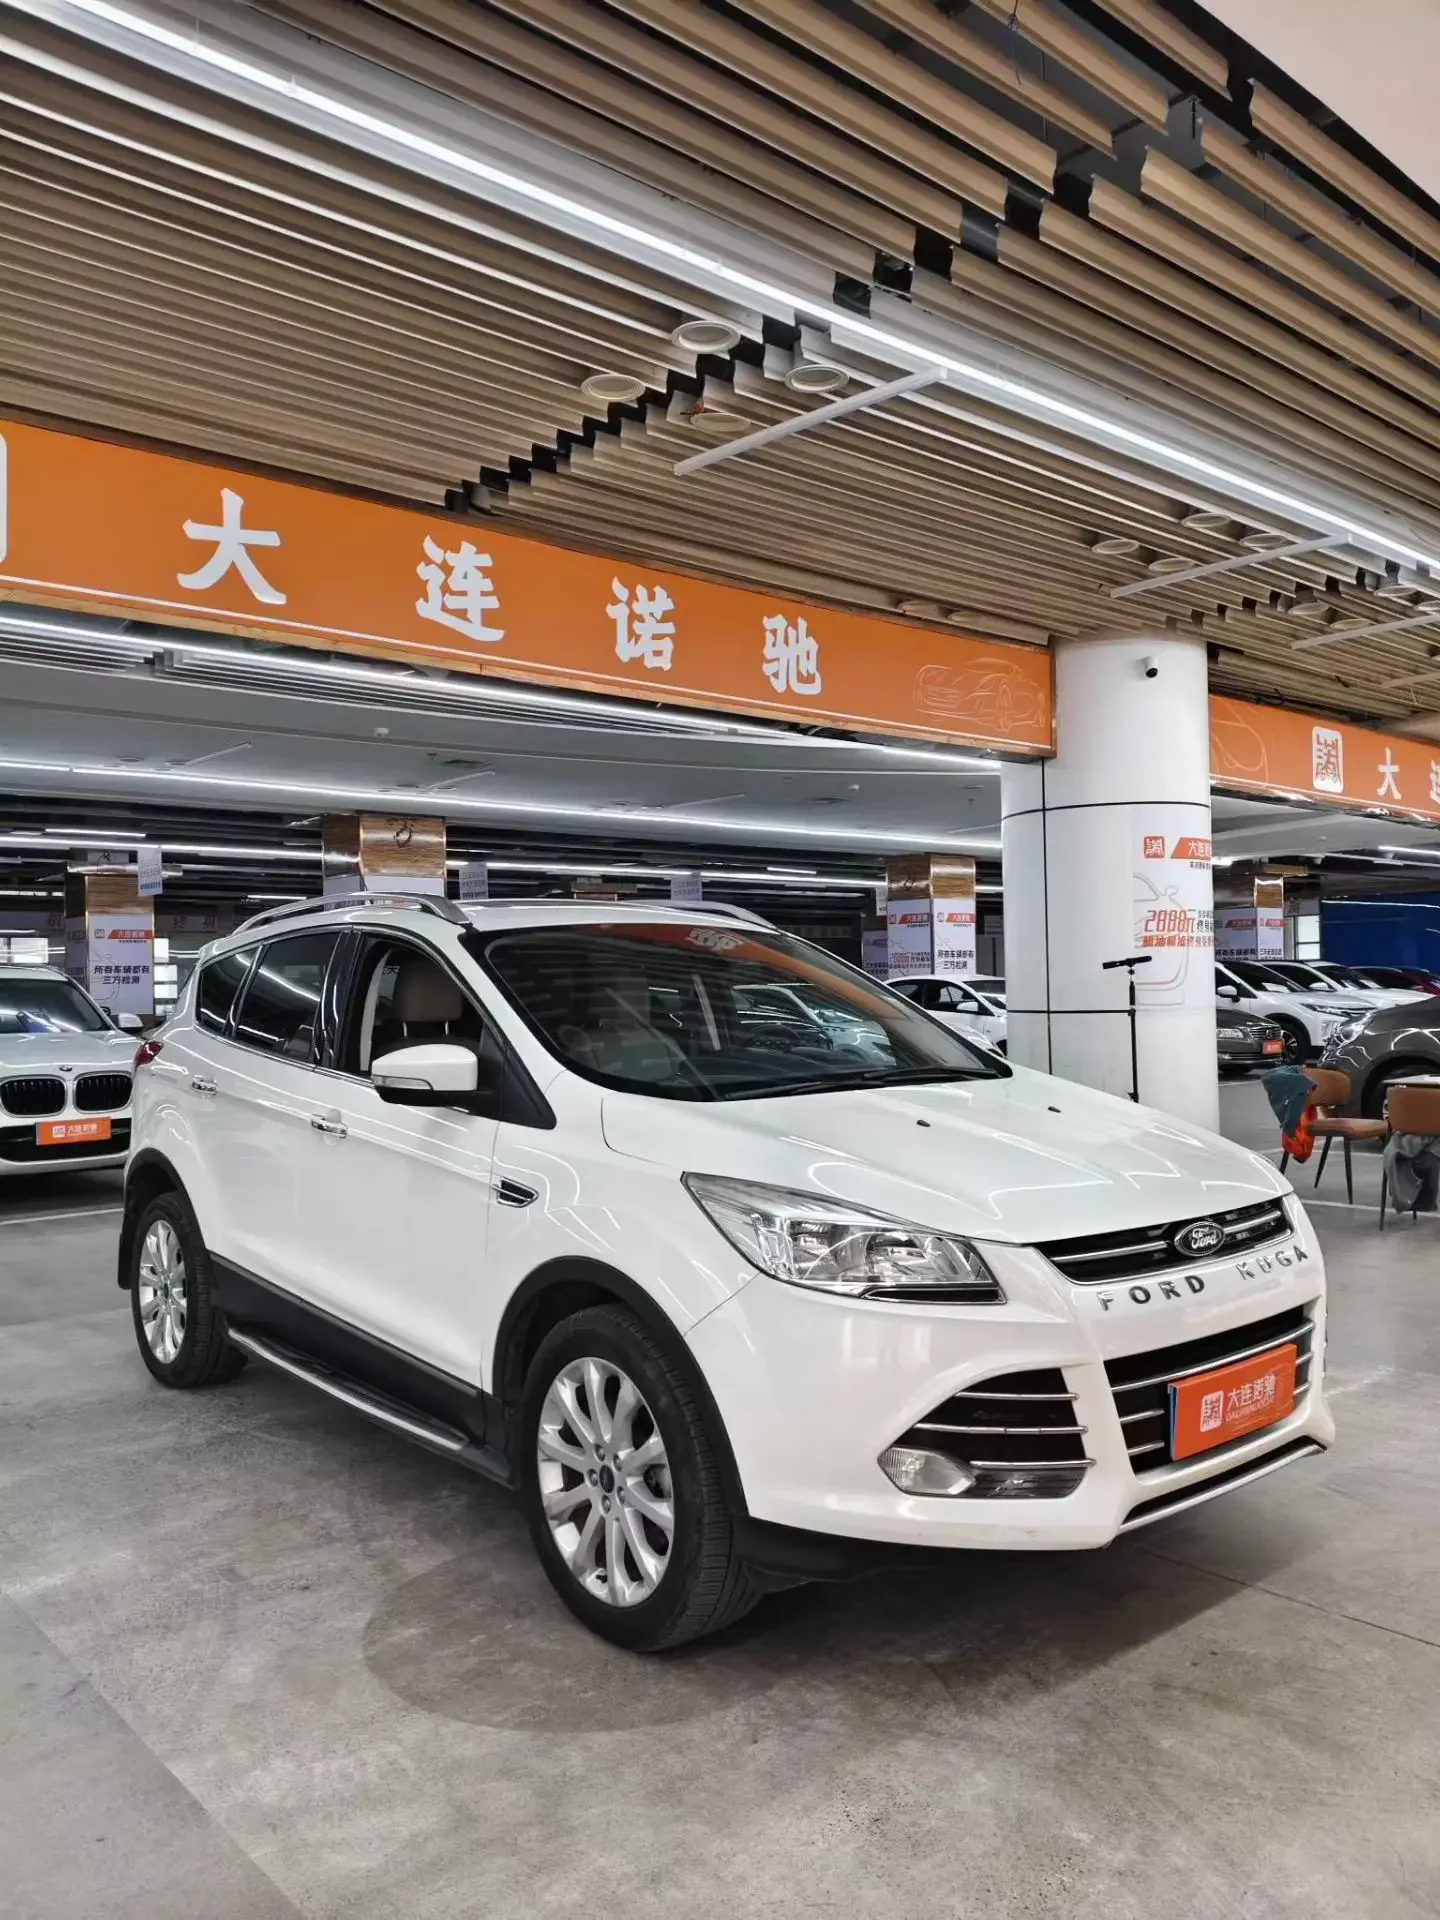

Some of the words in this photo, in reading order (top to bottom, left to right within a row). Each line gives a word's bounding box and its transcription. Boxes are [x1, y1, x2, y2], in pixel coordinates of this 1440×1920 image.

[176, 487, 822, 696] 大连诺驰
[1191, 1226, 1219, 1249] Ford
[1096, 1274, 1206, 1311] FORD
[1234, 1244, 1309, 1281] KUGA
